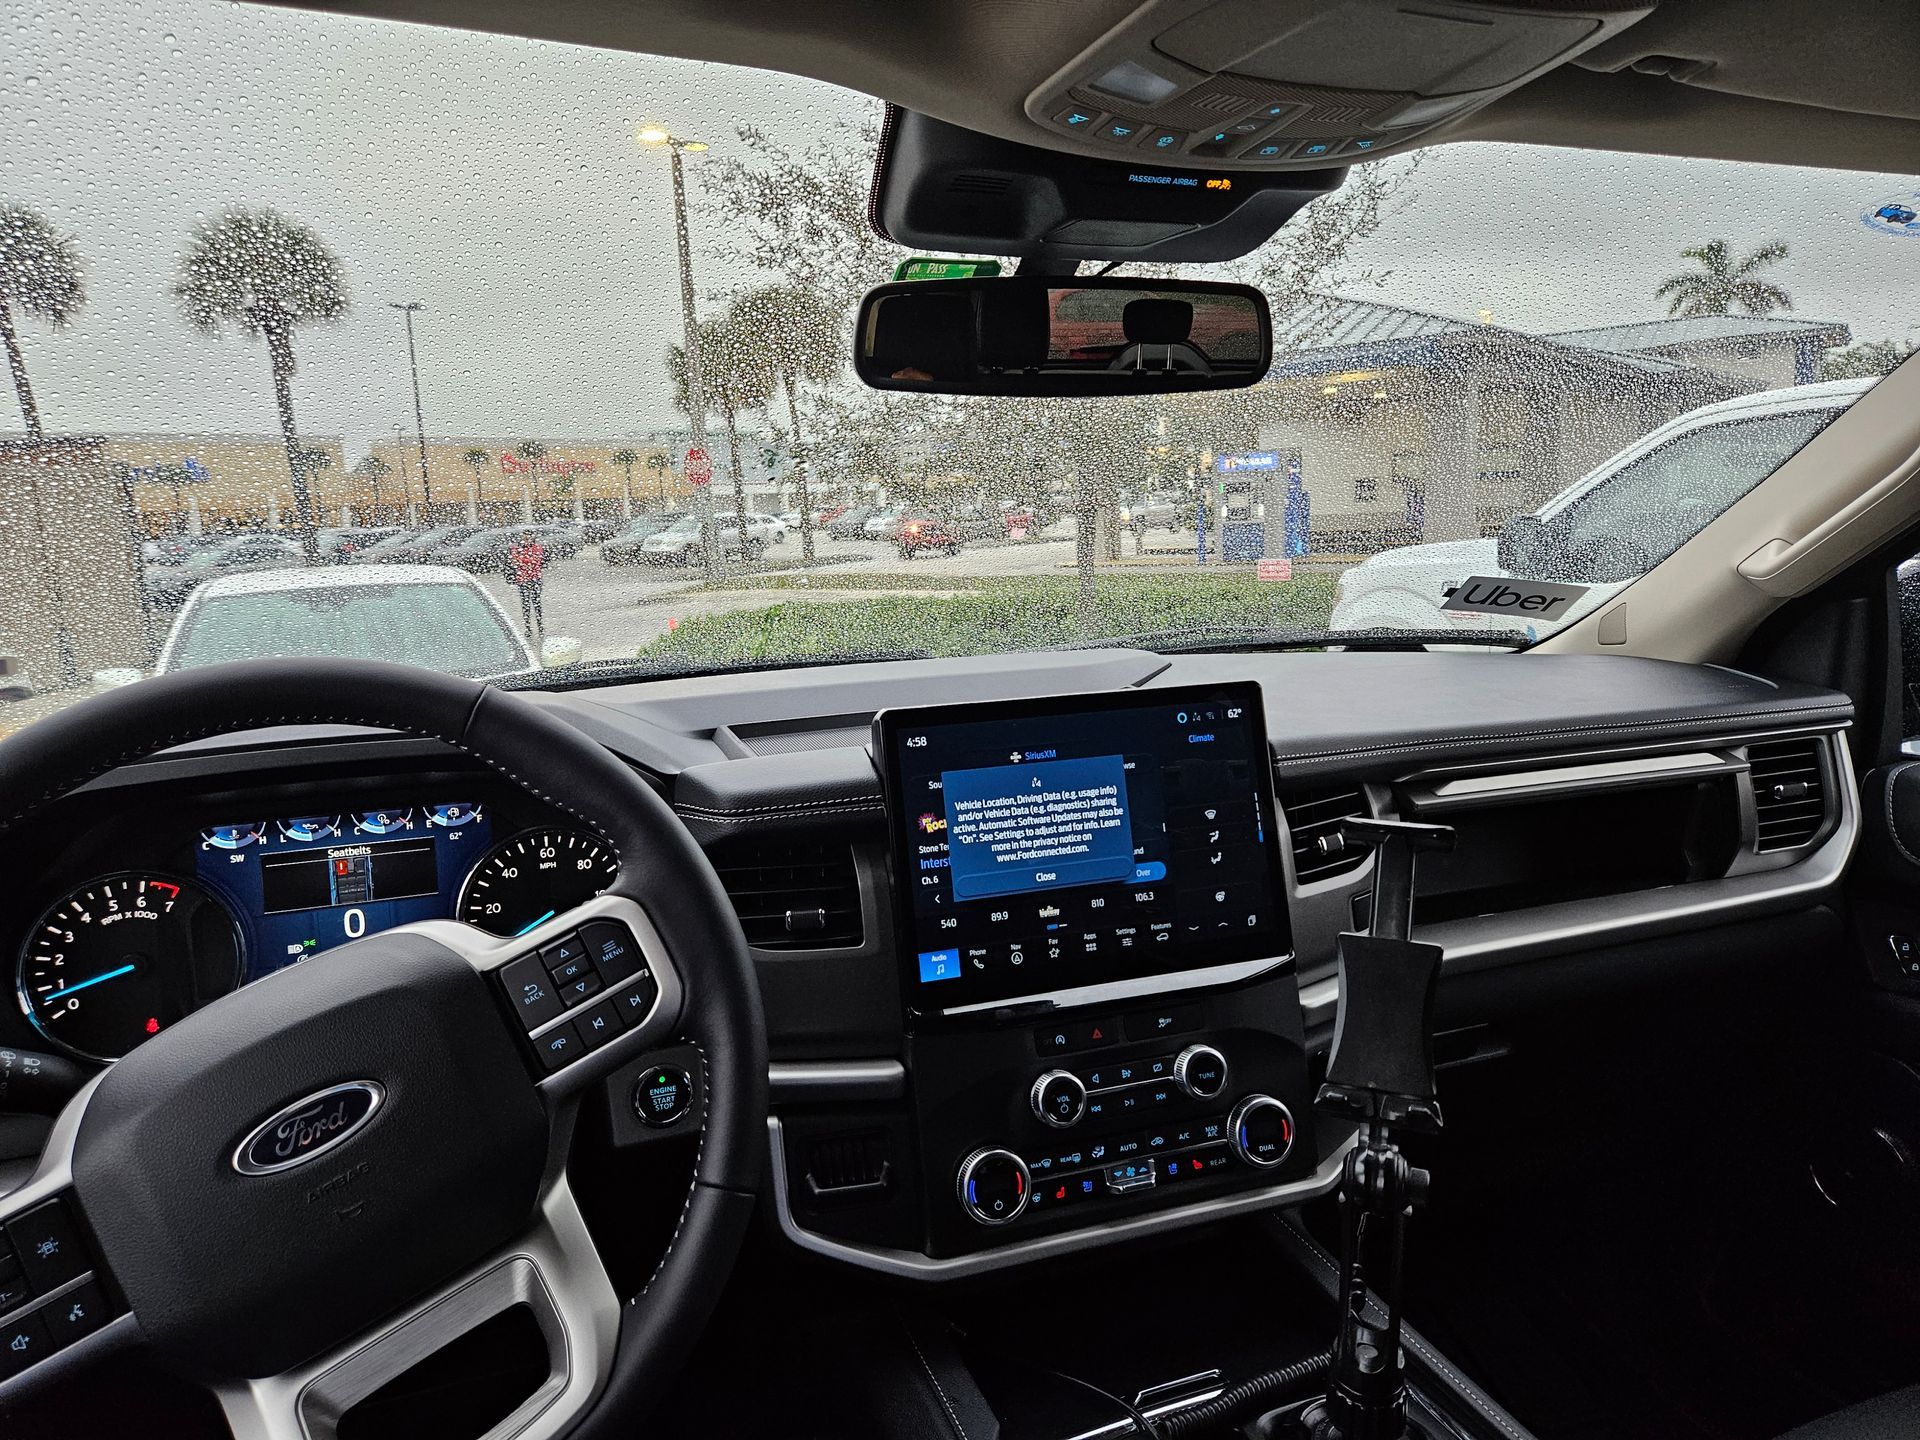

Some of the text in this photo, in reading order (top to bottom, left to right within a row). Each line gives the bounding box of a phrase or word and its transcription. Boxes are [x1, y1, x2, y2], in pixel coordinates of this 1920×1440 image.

[1128, 174, 1221, 188] PASSENGER AIRBAG OFF
[926, 263, 947, 274] PASS
[1463, 584, 1566, 612] Uber
[906, 737, 927, 748] 4:58
[1188, 733, 1215, 743] Climate
[1025, 750, 1057, 760] SiriusXM
[955, 785, 1117, 811] Vehicle Location, Driving Data (e.g. usage info)
[958, 797, 1117, 822] and/or Vehicle Data (e.g. diagnostics) sharing
[426, 819, 432, 828] E
[477, 814, 483, 823] F
[953, 807, 1124, 834] active. Automatic Software Updates may also be
[406, 822, 413, 830] H
[979, 833, 994, 842] See
[994, 829, 1025, 839] Settings
[1025, 828, 1034, 836] to
[1034, 825, 1058, 836] adjust
[1058, 822, 1072, 832] and
[1072, 822, 1083, 831] for
[1084, 820, 1100, 830] info.
[1100, 819, 1121, 828] Learn
[334, 829, 341, 837] H
[354, 827, 360, 836] C
[259, 836, 267, 845] H
[280, 835, 286, 843] L
[991, 833, 1093, 852] more in the privacy notice on
[202, 842, 209, 851] C
[327, 845, 371, 858] Seatbelts
[919, 845, 939, 854] Stone
[540, 847, 555, 858] 60
[996, 845, 1090, 862] www.Fordconnected.com.
[230, 854, 244, 863] SW
[539, 861, 557, 869] MPH
[577, 859, 592, 870] 80
[502, 867, 518, 878] 40
[1035, 872, 1056, 882] Close
[1136, 869, 1151, 877] Over
[921, 875, 939, 885] Ch. 6
[1135, 891, 1154, 902] 106.3
[109, 900, 118, 911] 5
[136, 897, 147, 908] 6
[165, 901, 174, 912] 7
[1091, 898, 1105, 908] 810
[486, 903, 501, 914] 20
[81, 912, 92, 923] 4
[101, 913, 123, 925] RPM
[134, 911, 158, 920] 1000
[991, 911, 1009, 922] 89.9
[344, 908, 366, 938] 0
[941, 918, 957, 929] 540
[1150, 922, 1172, 931] Features
[65, 931, 74, 942] 3
[1116, 927, 1136, 936] Settings
[1083, 933, 1097, 941] Apps
[602, 947, 624, 962] MENU
[931, 954, 948, 962] Audio
[969, 949, 987, 957] Phone
[54, 954, 64, 965] 2
[566, 965, 578, 975] OK
[58, 979, 65, 989] 1
[523, 990, 545, 1005] BACK
[67, 999, 79, 1009] 0
[1198, 1071, 1215, 1079] TUNE
[650, 1085, 677, 1096] ENGINE
[652, 1095, 675, 1106] START
[1056, 1095, 1070, 1103] VOL
[655, 1102, 674, 1111] STOP
[275, 1101, 348, 1157] Ford
[1205, 1125, 1218, 1133] MAX
[1178, 1132, 1190, 1140] A/C
[1120, 1142, 1138, 1152] AUTO
[1259, 1143, 1275, 1152] DUAL
[1210, 1158, 1226, 1167] REAR
